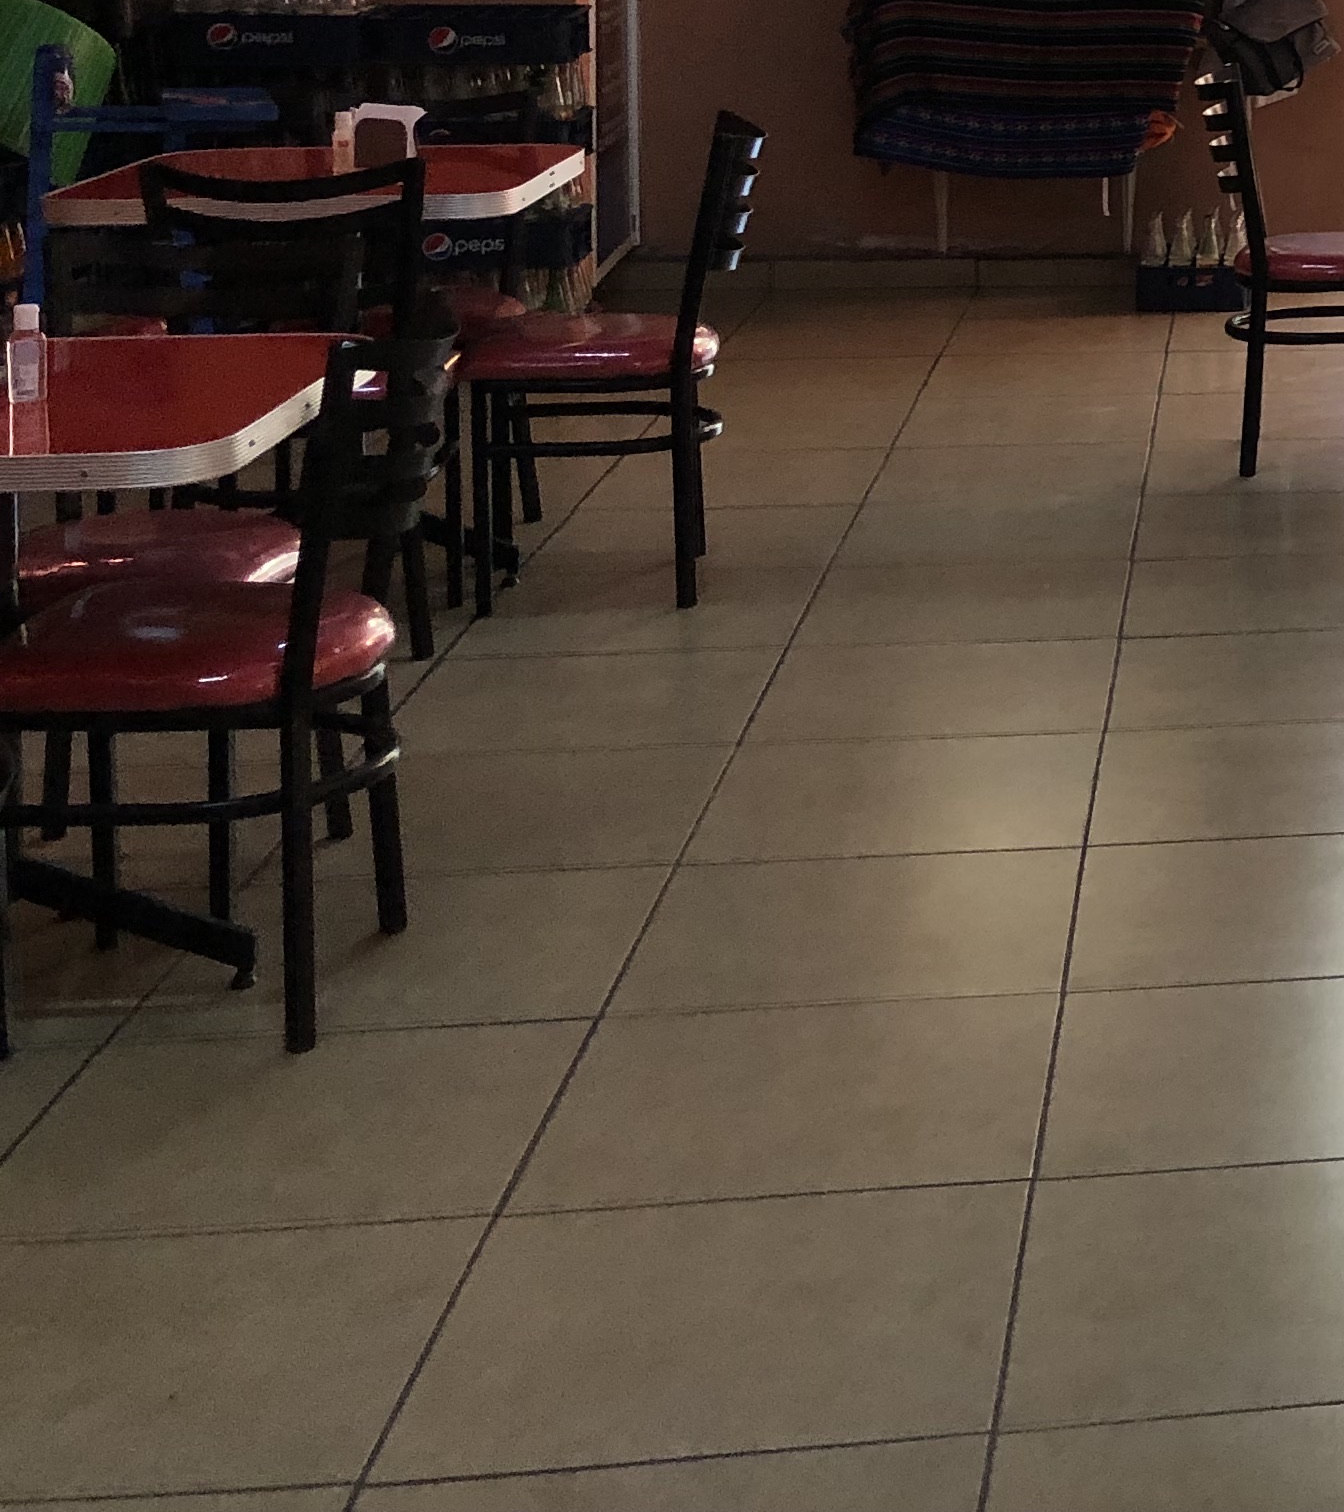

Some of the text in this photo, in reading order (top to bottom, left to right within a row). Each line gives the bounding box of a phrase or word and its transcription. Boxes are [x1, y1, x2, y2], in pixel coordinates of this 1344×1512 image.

[240, 30, 294, 47] pepsi
[460, 32, 507, 48] pepsi
[453, 238, 506, 256] peps
